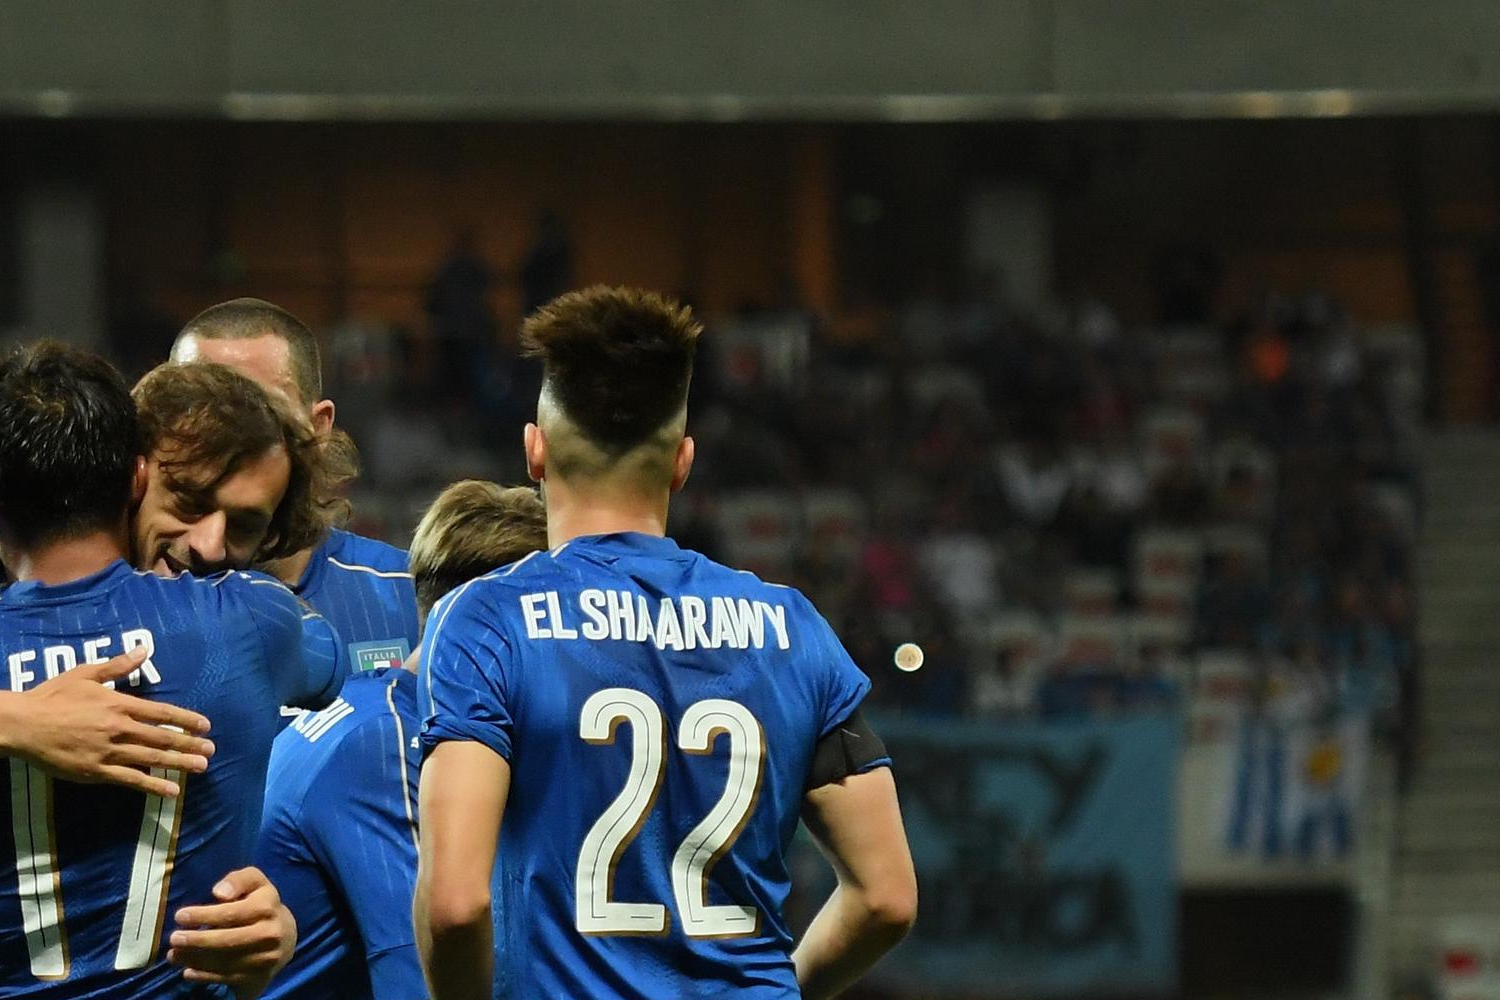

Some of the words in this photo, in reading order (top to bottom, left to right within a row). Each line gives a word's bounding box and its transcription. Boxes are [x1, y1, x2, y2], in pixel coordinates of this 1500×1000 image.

[520, 591, 578, 640] EL
[581, 589, 790, 651] SHAARAWY
[364, 651, 397, 661] ITALIA
[575, 687, 767, 938] 22
